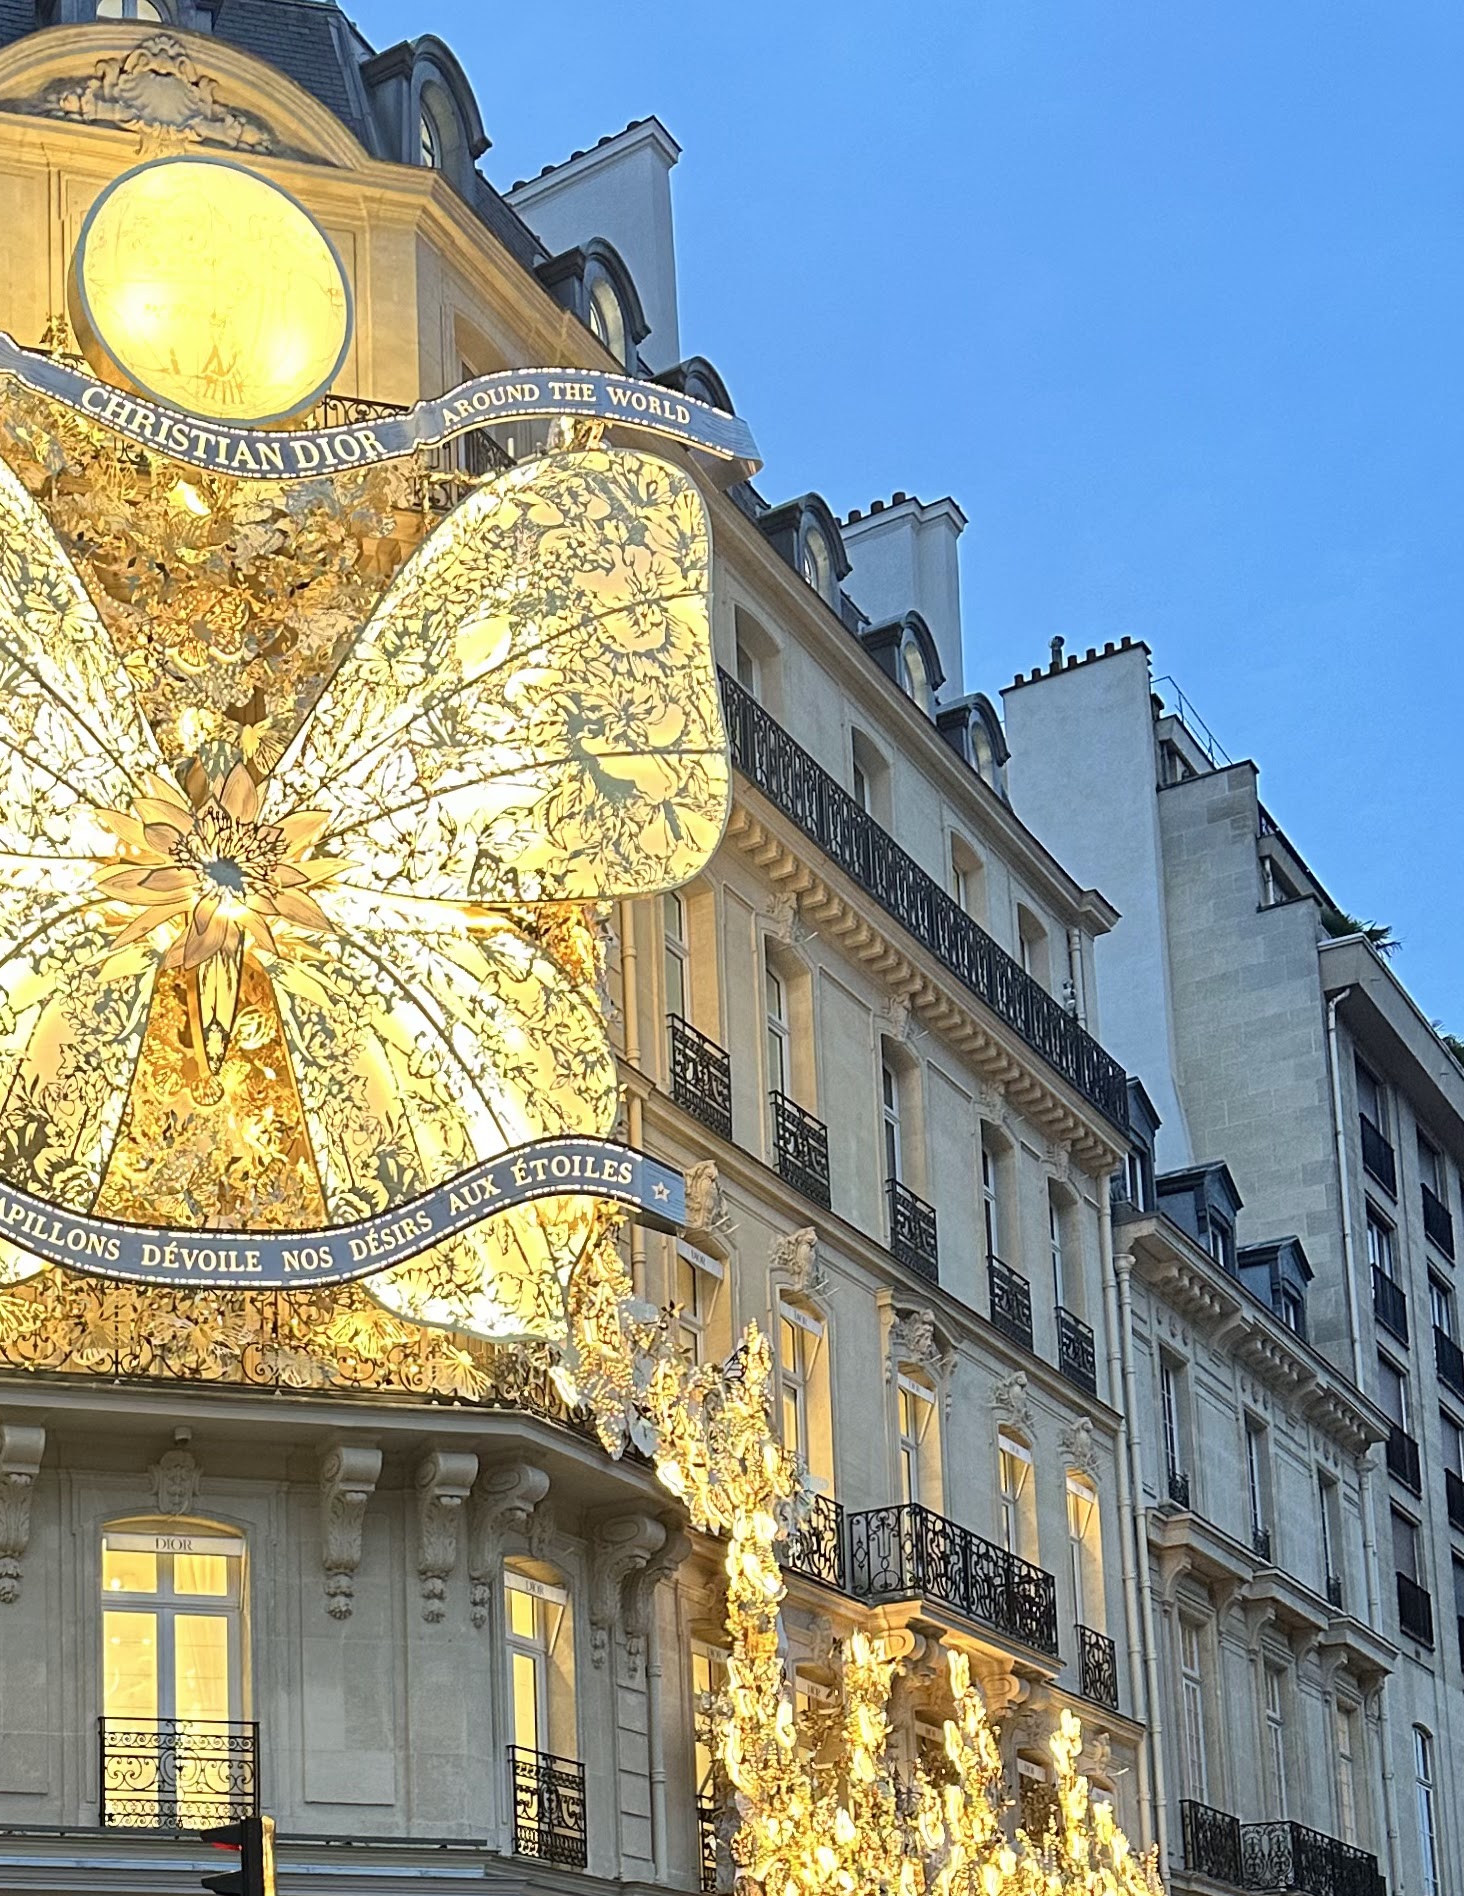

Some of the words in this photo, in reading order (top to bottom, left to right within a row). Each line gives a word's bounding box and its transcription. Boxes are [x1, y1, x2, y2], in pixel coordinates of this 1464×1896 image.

[82, 385, 285, 471] CHRISTIAN
[297, 430, 386, 470] DIOR
[442, 382, 540, 426] AROUND
[548, 382, 597, 402] THE
[606, 385, 691, 424] WORLD
[141, 1243, 261, 1272] DÉVOILE
[283, 1245, 333, 1271] NOS
[349, 1210, 433, 1262] DÉSIRS
[448, 1173, 502, 1215] AUX
[513, 1155, 633, 1187] ÉTOILES
[156, 1538, 193, 1551] DIOR
